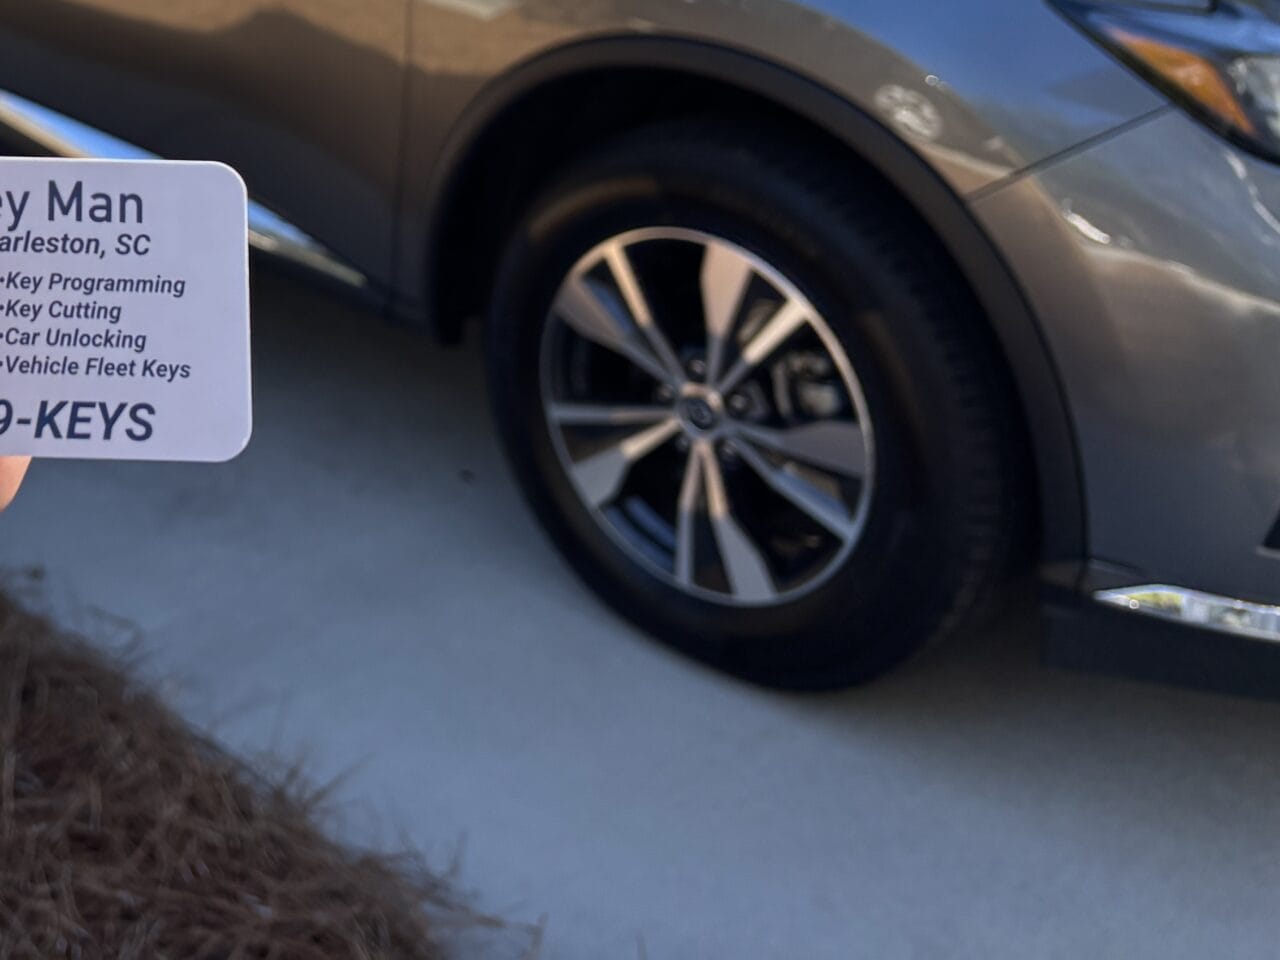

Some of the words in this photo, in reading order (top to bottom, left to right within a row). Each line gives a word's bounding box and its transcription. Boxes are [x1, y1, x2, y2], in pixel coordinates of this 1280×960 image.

[47, 179, 144, 224] Man
[114, 233, 152, 256] SC
[5, 271, 44, 295] Key
[48, 272, 187, 299] Programming
[4, 299, 44, 323] Key
[48, 300, 122, 325] Cutting
[4, 327, 41, 346] Car
[45, 328, 148, 354] Unlocking
[5, 355, 80, 376] Vehicle
[84, 356, 137, 377] Fleet
[141, 359, 192, 383] Keys
